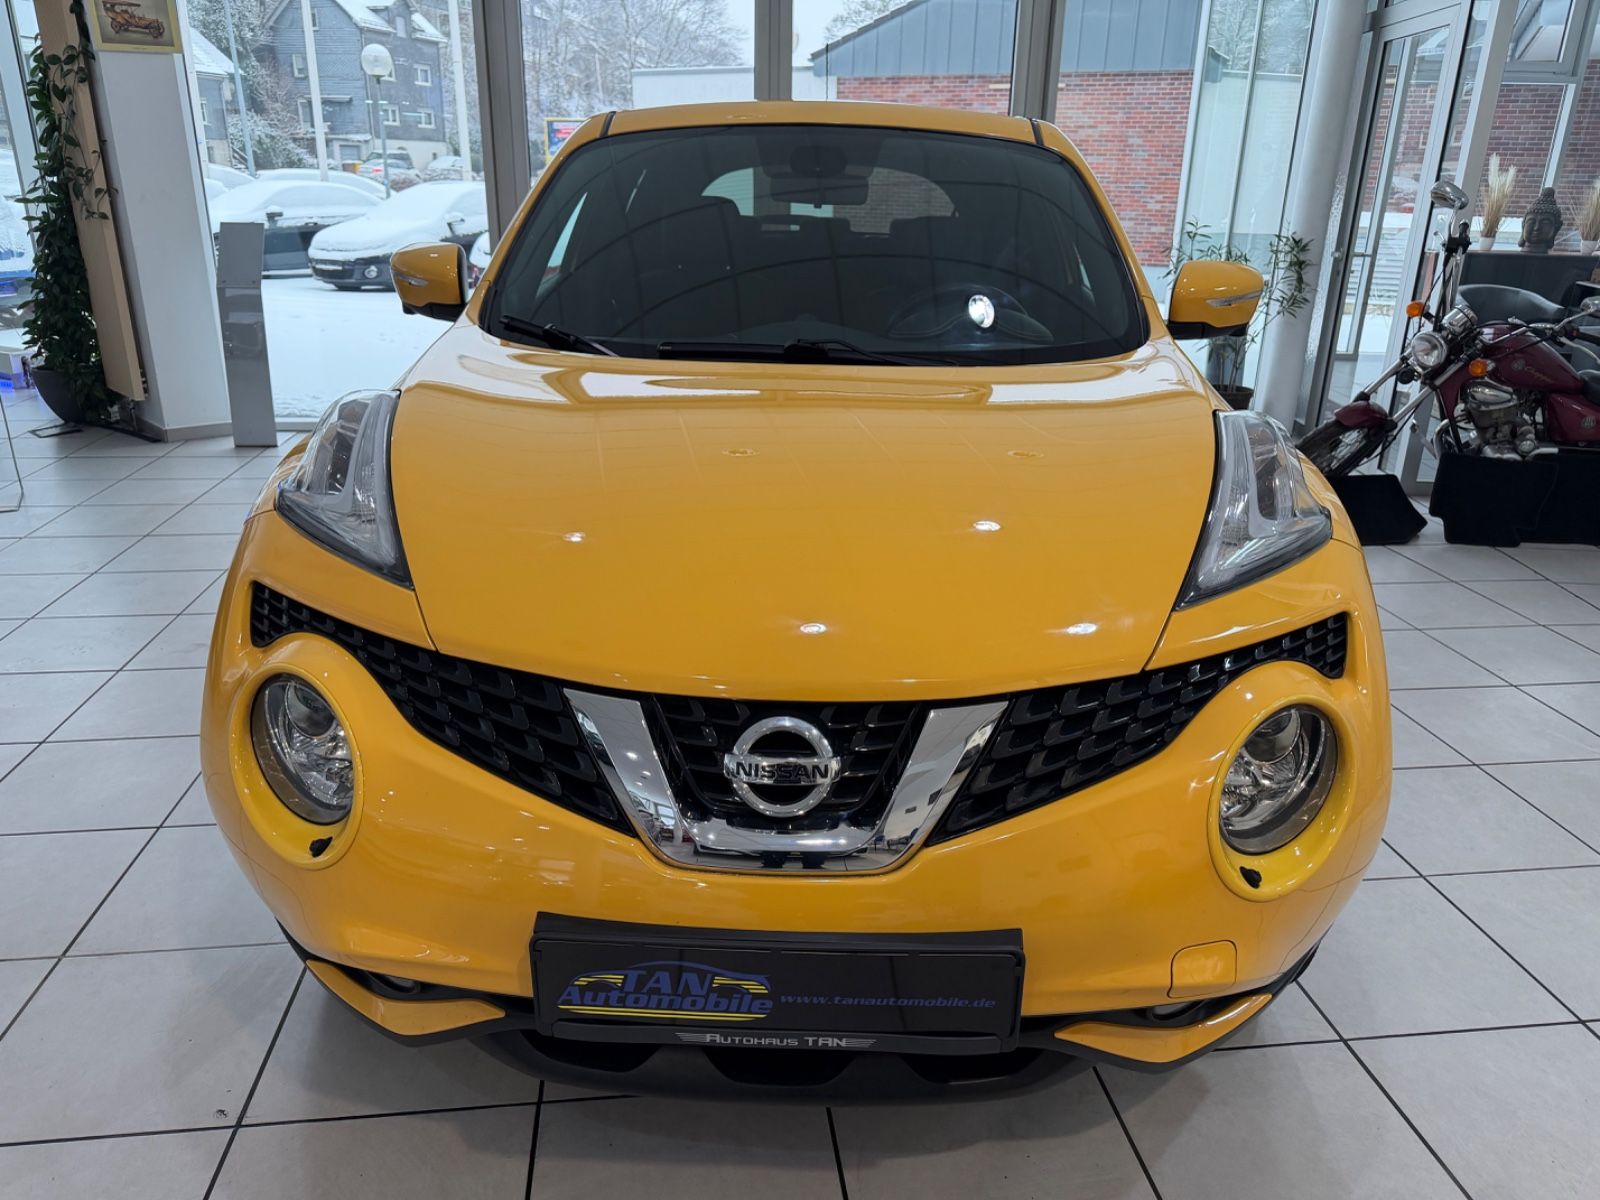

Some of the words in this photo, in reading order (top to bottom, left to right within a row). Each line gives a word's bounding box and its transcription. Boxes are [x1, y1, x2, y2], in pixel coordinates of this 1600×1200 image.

[735, 761, 829, 780] NISSAN
[622, 970, 712, 995] TAN
[558, 986, 773, 1013] Automobile
[780, 995, 996, 1009] www.tanautomobile.de
[803, 1036, 848, 1048] TAN
